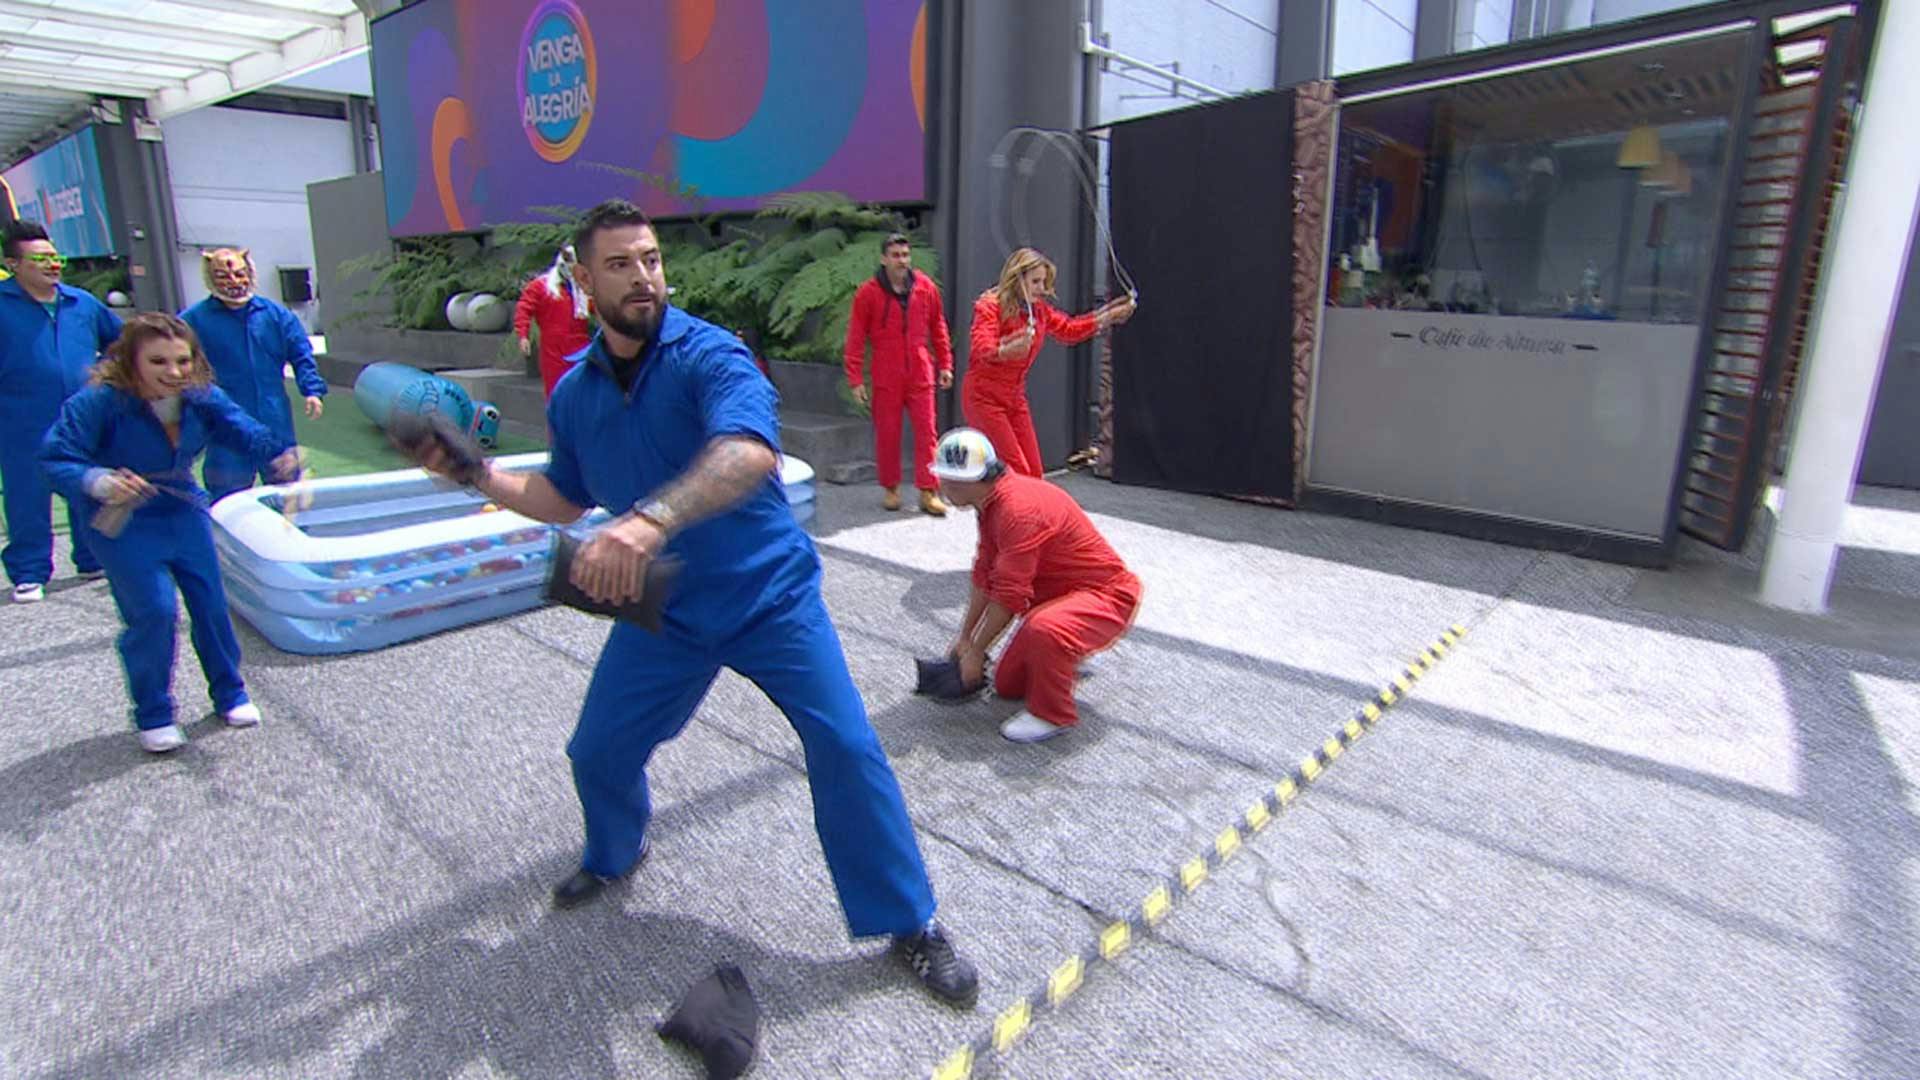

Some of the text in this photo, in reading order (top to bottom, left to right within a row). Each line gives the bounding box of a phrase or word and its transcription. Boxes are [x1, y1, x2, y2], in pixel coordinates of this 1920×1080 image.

[527, 33, 585, 72] VENGA
[549, 72, 561, 87] LA
[523, 76, 593, 128] ALEGRÍA
